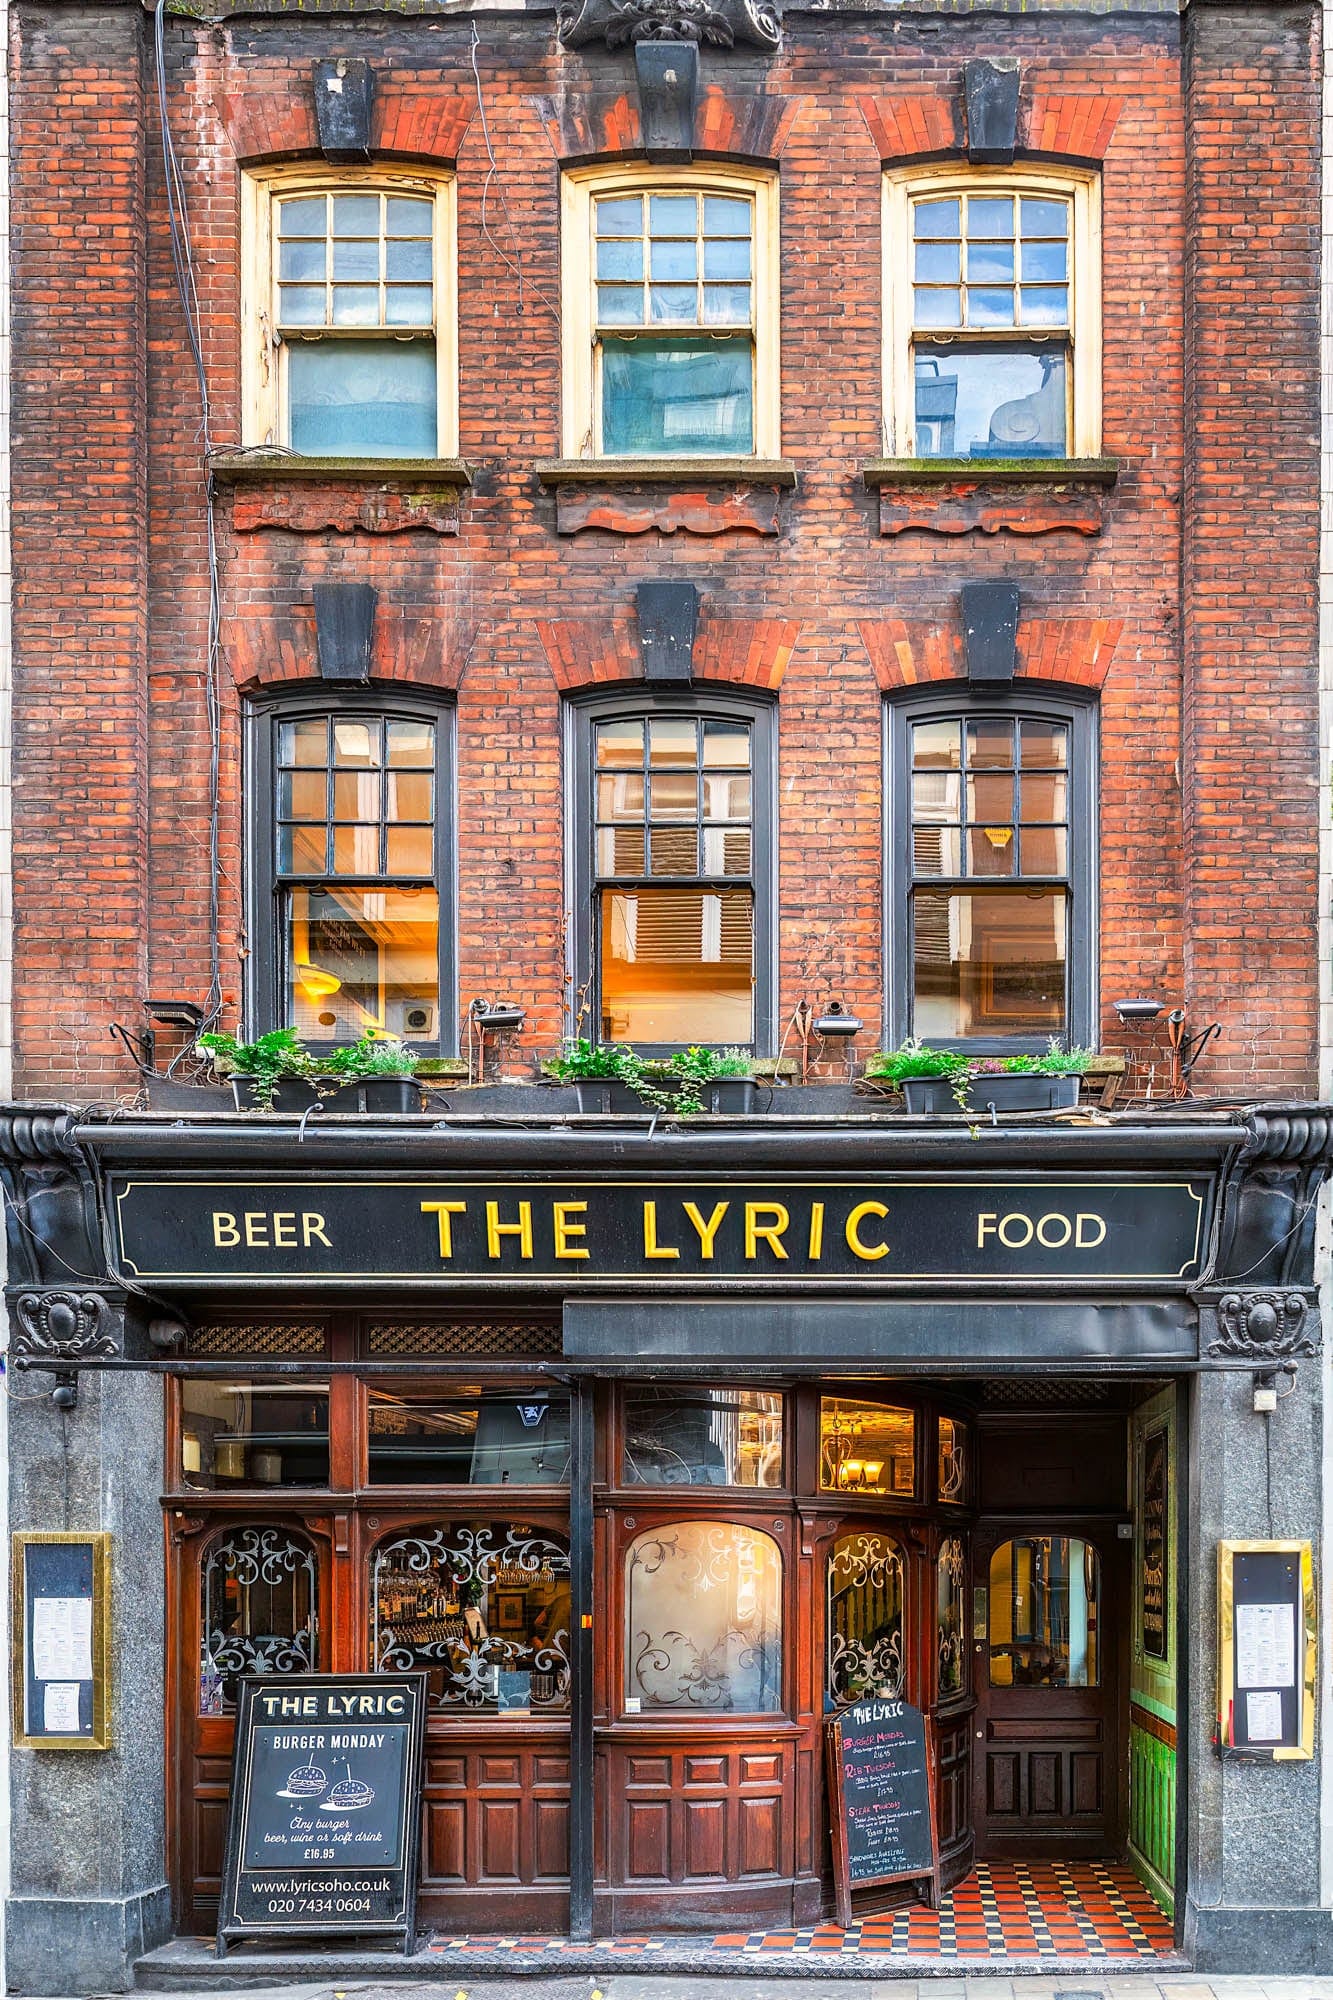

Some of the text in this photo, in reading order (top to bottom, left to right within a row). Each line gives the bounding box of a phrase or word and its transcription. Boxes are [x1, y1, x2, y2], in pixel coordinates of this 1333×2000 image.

[212, 1212, 333, 1247] BEER
[421, 1201, 890, 1260] THE LYRIC
[978, 1213, 1110, 1248] FOOD
[263, 1694, 405, 1716] THE LYRIC
[873, 1702, 904, 1720] LYRIC
[273, 1734, 386, 1749] BURGER MONDAY
[289, 1816, 351, 1832] Any burger
[263, 1831, 383, 1845] beer, wine or soft drink
[303, 1848, 335, 1859] £16.95
[251, 1878, 391, 1896] www.lyricsoho.co.uk
[268, 1898, 371, 1913] 020 7434 0604
